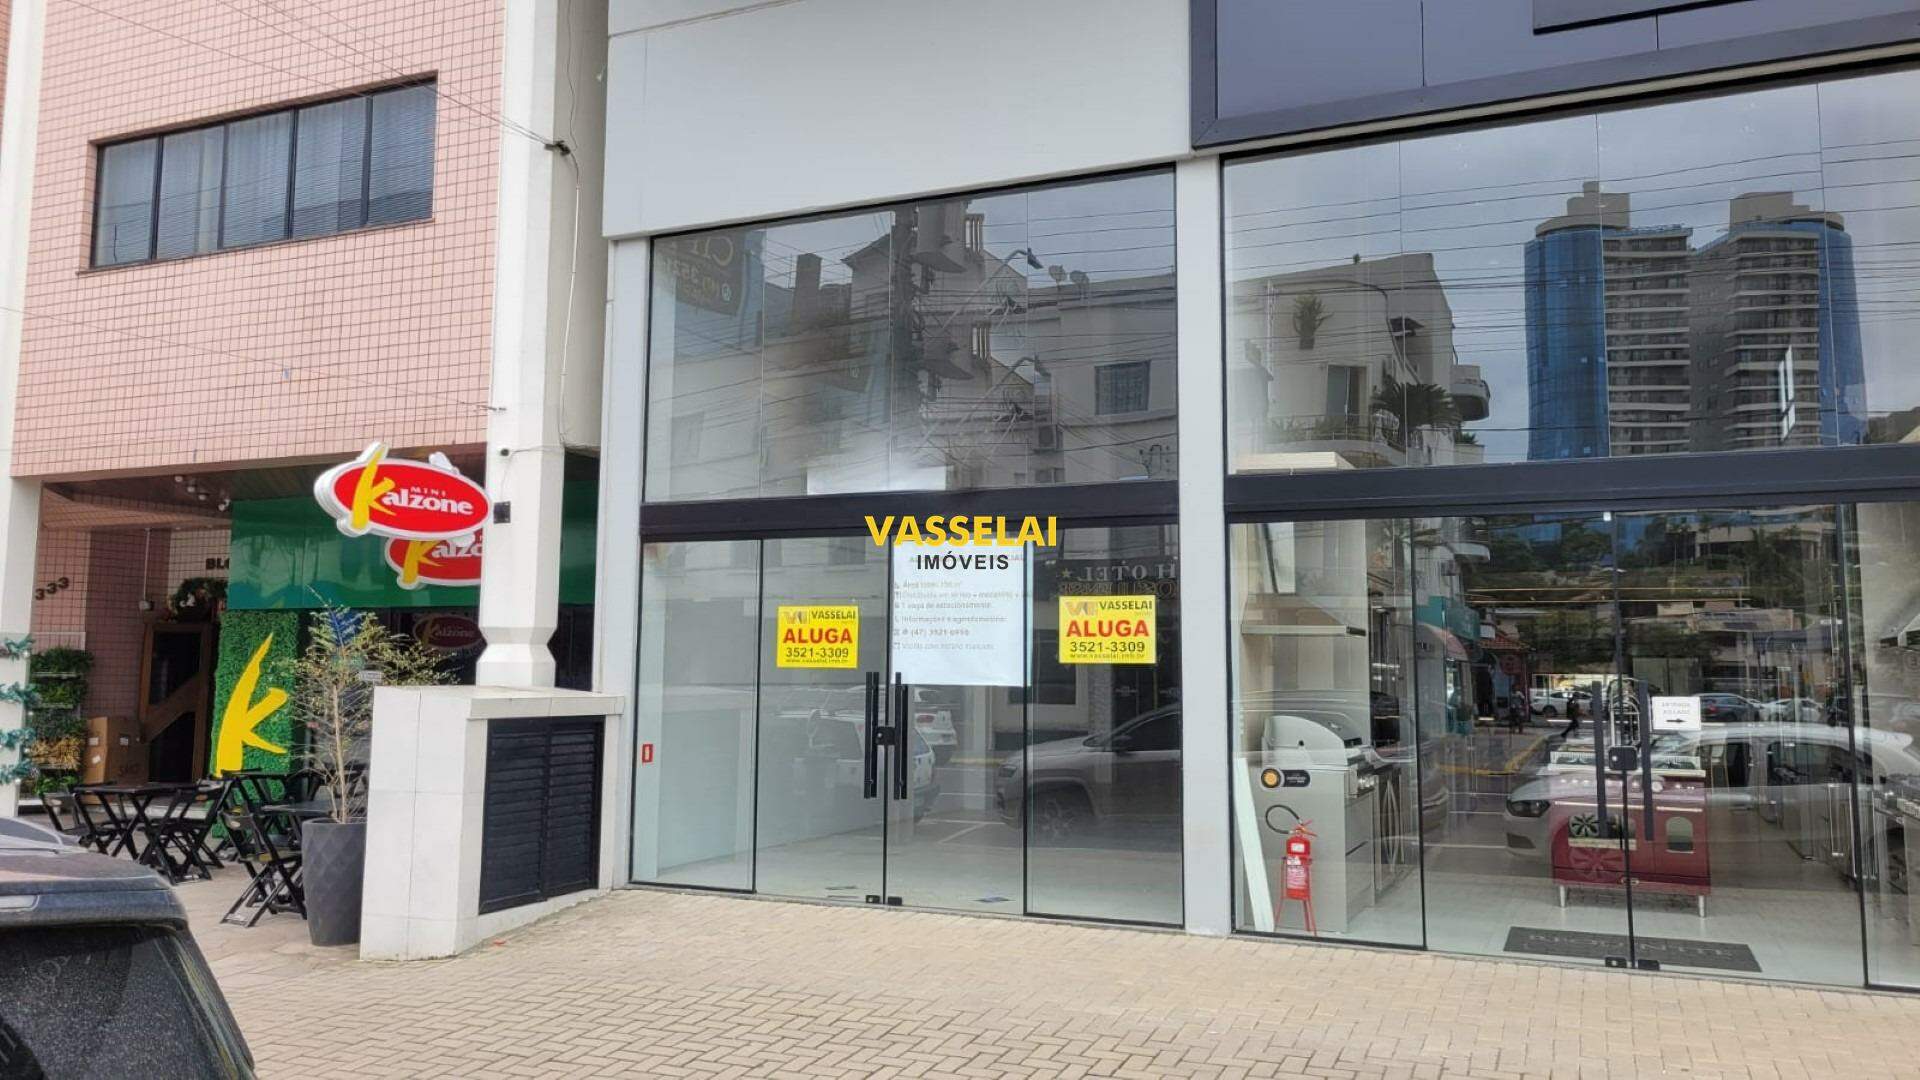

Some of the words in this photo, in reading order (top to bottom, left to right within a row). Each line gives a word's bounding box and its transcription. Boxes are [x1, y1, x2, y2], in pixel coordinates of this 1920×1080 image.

[410, 486, 446, 496] MINI
[1099, 600, 1153, 610] VASSELAI
[811, 610, 856, 620] VASSELAI
[1066, 619, 1150, 638] ALUGA
[782, 627, 854, 645] ALUGA
[785, 647, 849, 659] 3521-3309
[1070, 641, 1145, 653] 3521-3309
